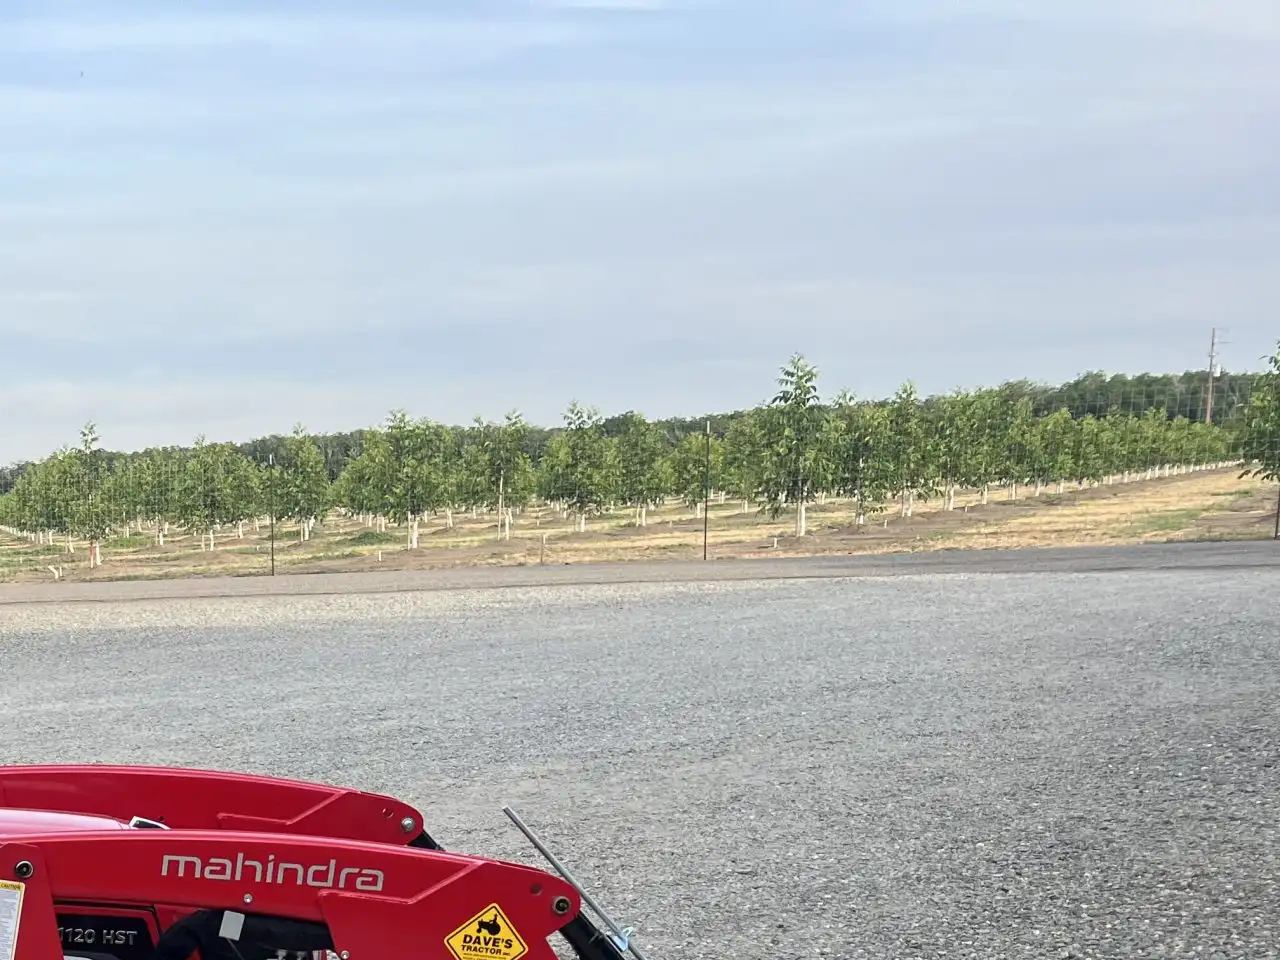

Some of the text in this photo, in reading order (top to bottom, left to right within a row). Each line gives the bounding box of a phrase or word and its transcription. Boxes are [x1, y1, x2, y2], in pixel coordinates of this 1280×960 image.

[160, 852, 385, 892] mahindra
[102, 929, 138, 945] HST
[463, 934, 513, 949] DAVE'S
[461, 944, 502, 955] TRACTOR
